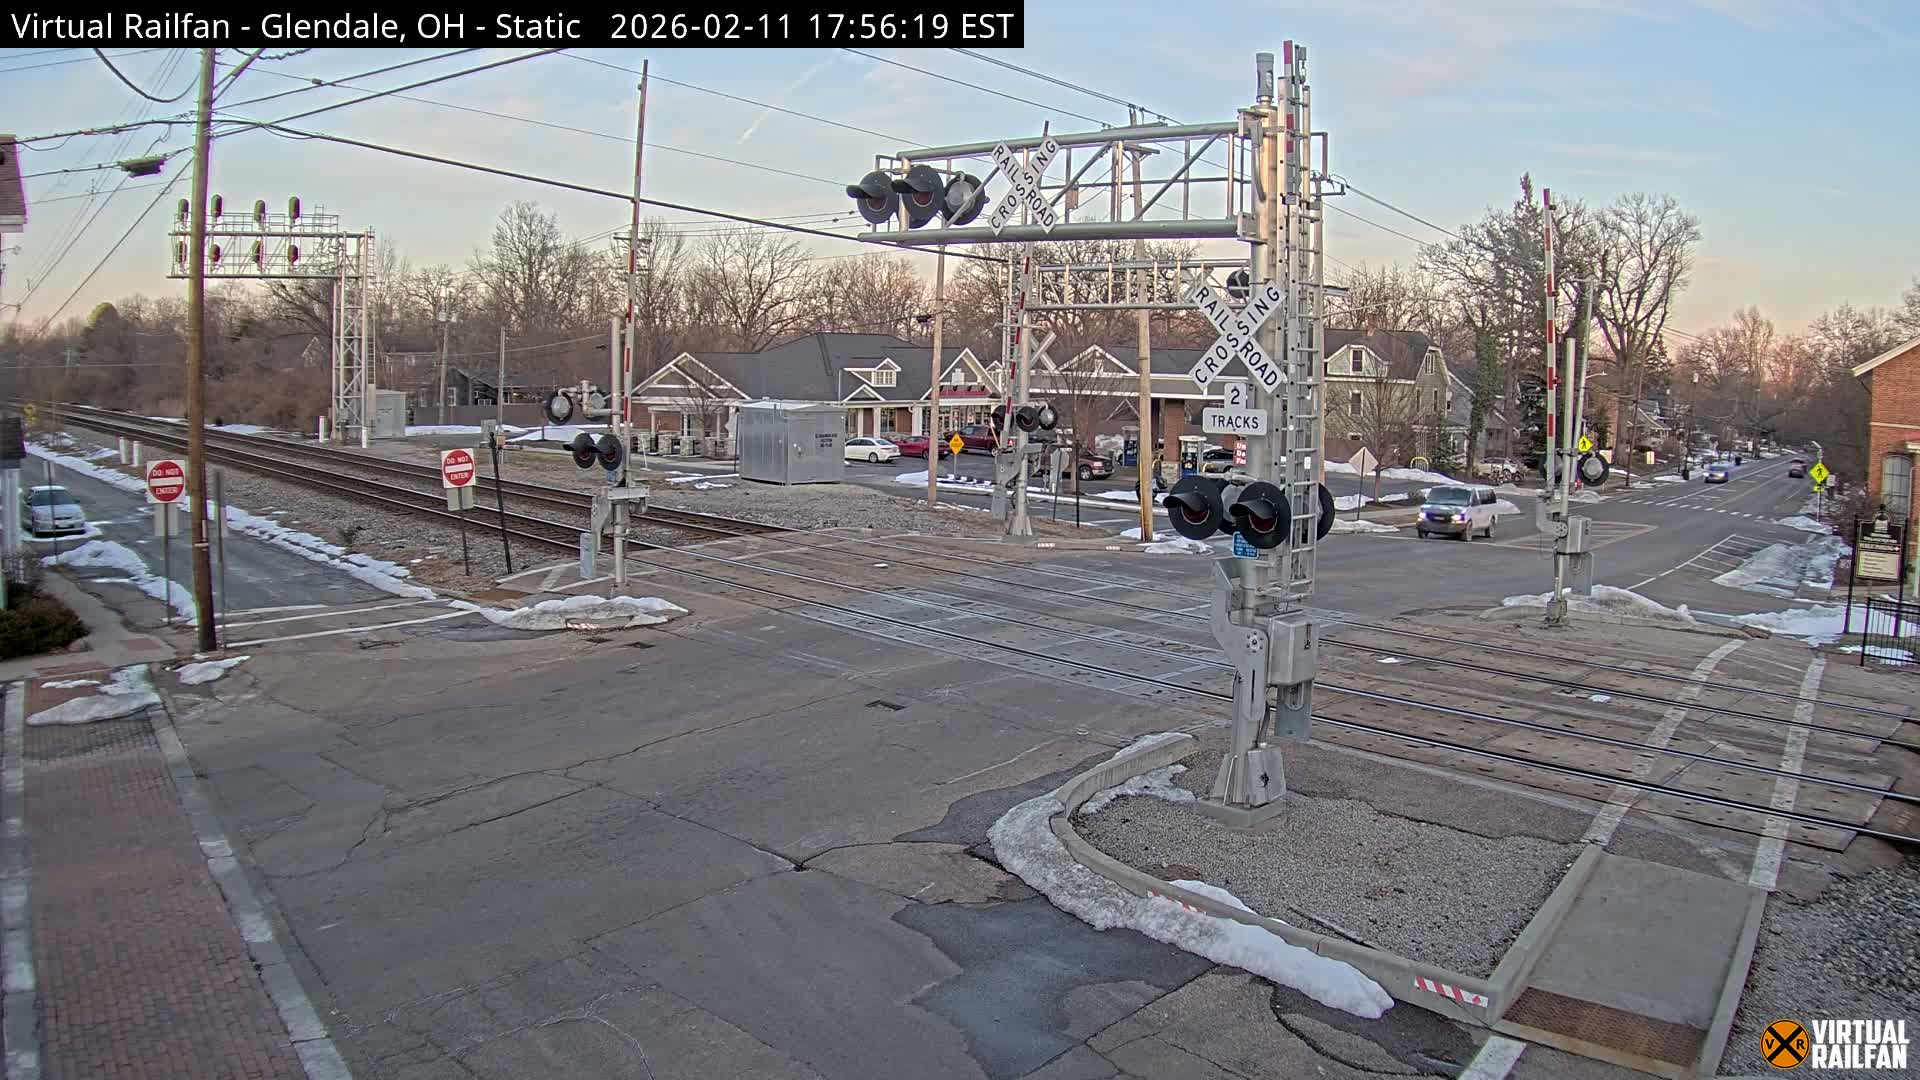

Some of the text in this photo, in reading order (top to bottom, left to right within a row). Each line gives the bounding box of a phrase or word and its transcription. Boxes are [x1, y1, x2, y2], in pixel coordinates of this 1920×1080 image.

[991, 140, 1056, 229] CROSSING
[1195, 286, 1280, 384] CROSSING
[1230, 388, 1241, 405] 2
[1211, 414, 1259, 430] TRACKS
[450, 472, 468, 480] ENTER
